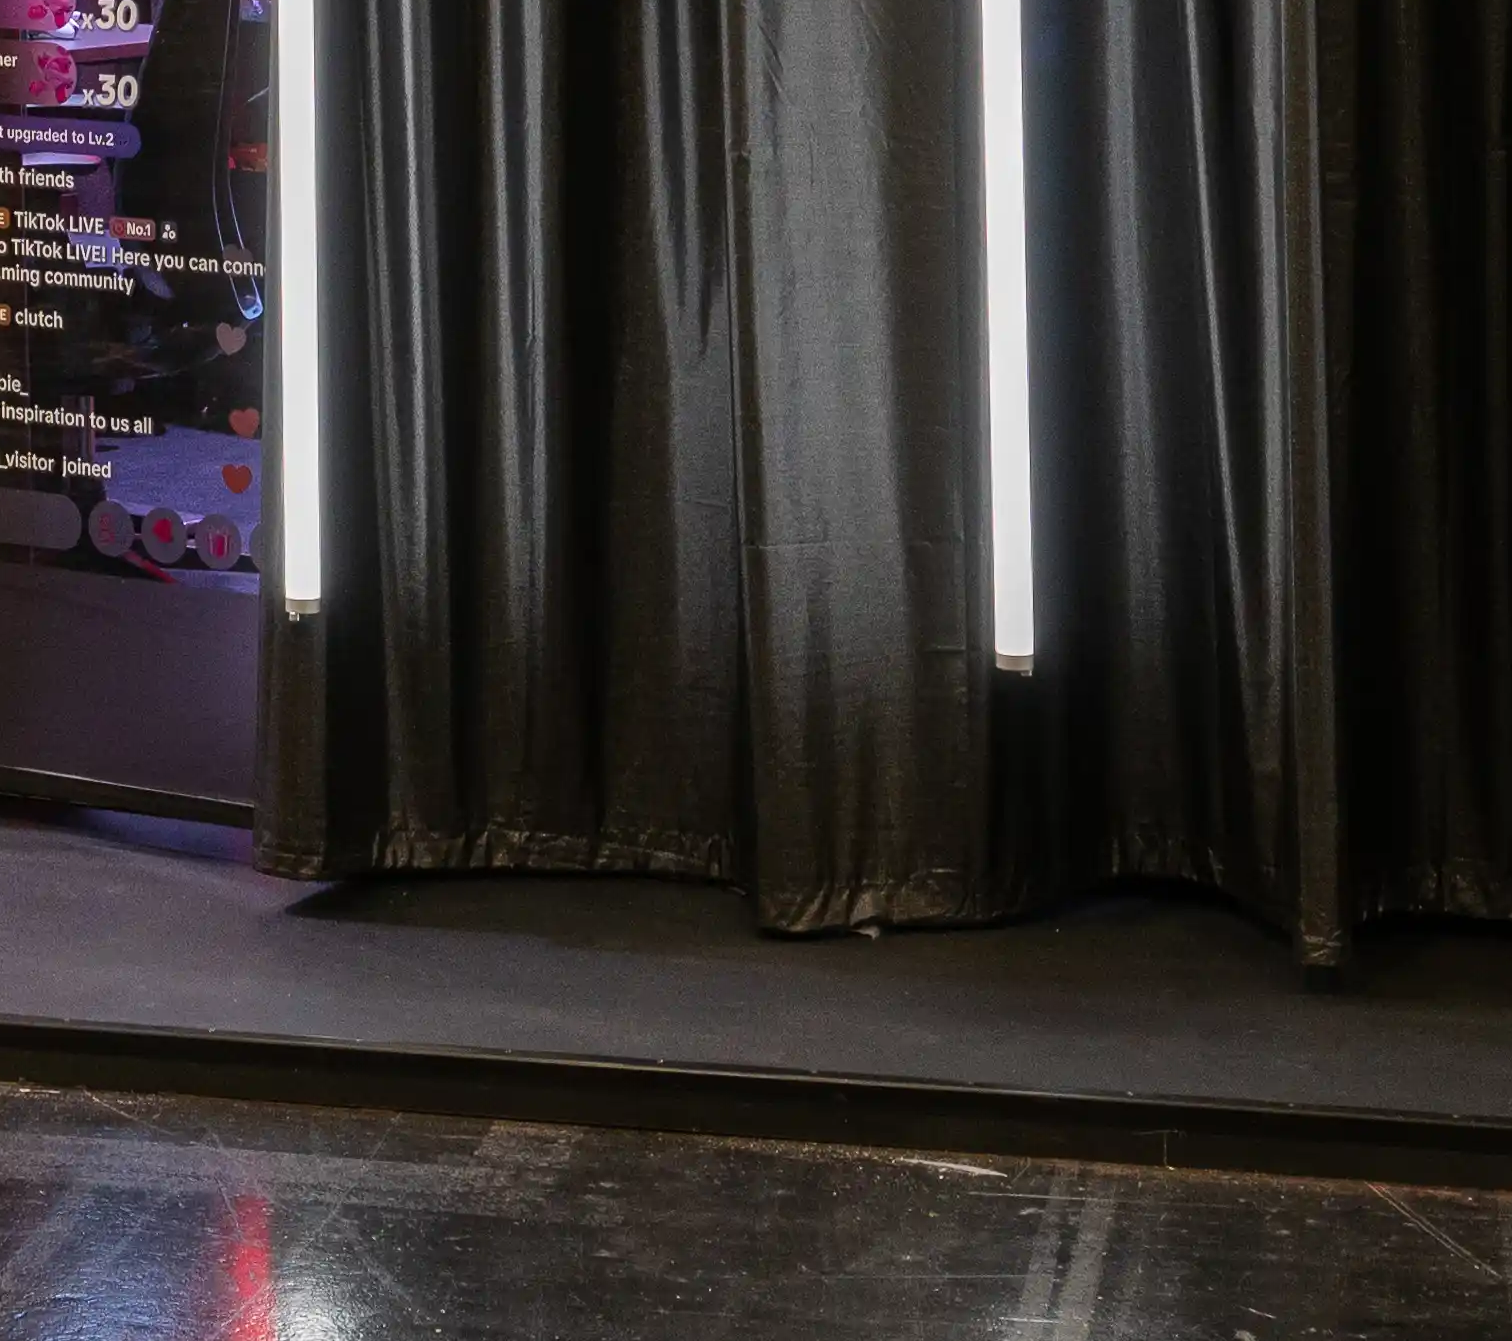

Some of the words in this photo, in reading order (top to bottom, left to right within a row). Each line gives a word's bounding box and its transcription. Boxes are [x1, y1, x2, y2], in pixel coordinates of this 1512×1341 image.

[82, 74, 138, 107] x30
[6, 125, 67, 144] upgraded
[72, 130, 85, 144] to
[88, 130, 114, 147] Lv.2
[18, 167, 74, 189] friends
[14, 211, 64, 232] TikTok
[69, 216, 104, 234] LIVE
[126, 222, 151, 237] No.1
[11, 240, 62, 260] TikTok
[66, 243, 106, 263] LIVE!
[111, 247, 150, 267] Here
[155, 252, 184, 272] you
[189, 256, 218, 273] can
[223, 260, 266, 277] conn
[44, 271, 134, 296] community
[15, 310, 63, 329] clutch
[1, 401, 85, 428] inspiration
[90, 411, 106, 429] to
[110, 416, 129, 431] us
[134, 416, 152, 434] all
[62, 455, 112, 478] joined
